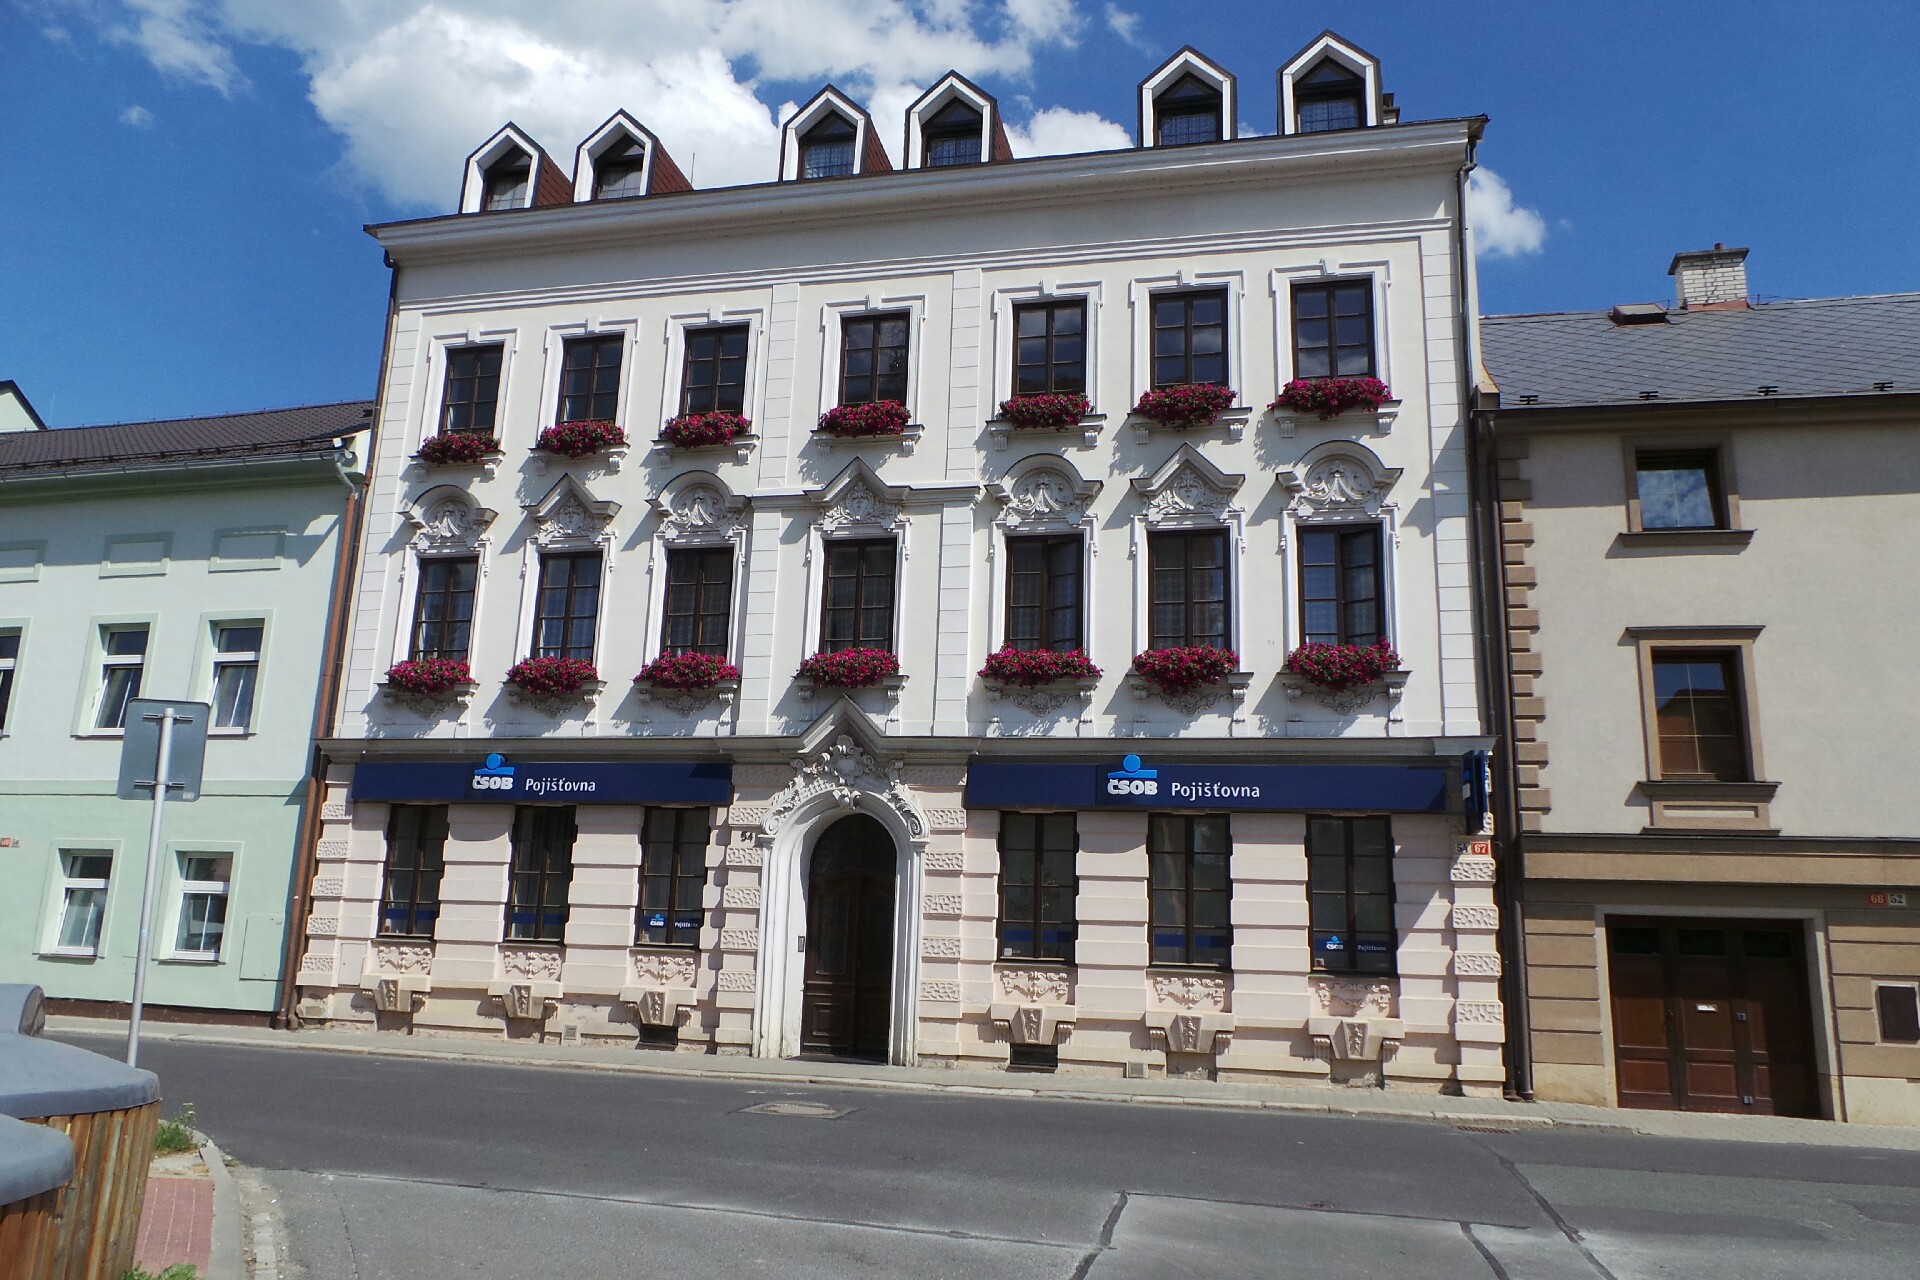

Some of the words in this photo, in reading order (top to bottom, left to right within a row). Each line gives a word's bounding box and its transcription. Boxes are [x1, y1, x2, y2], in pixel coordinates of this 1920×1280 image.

[472, 775, 514, 790] ČSOB
[525, 778, 596, 796] Pojišťovna
[1107, 778, 1158, 796] ČSOB
[1171, 782, 1260, 801] Pojišťovna
[741, 831, 754, 843] 54
[1474, 844, 1487, 854] 67
[1870, 894, 1885, 904] 66
[1890, 894, 1904, 904] 52
